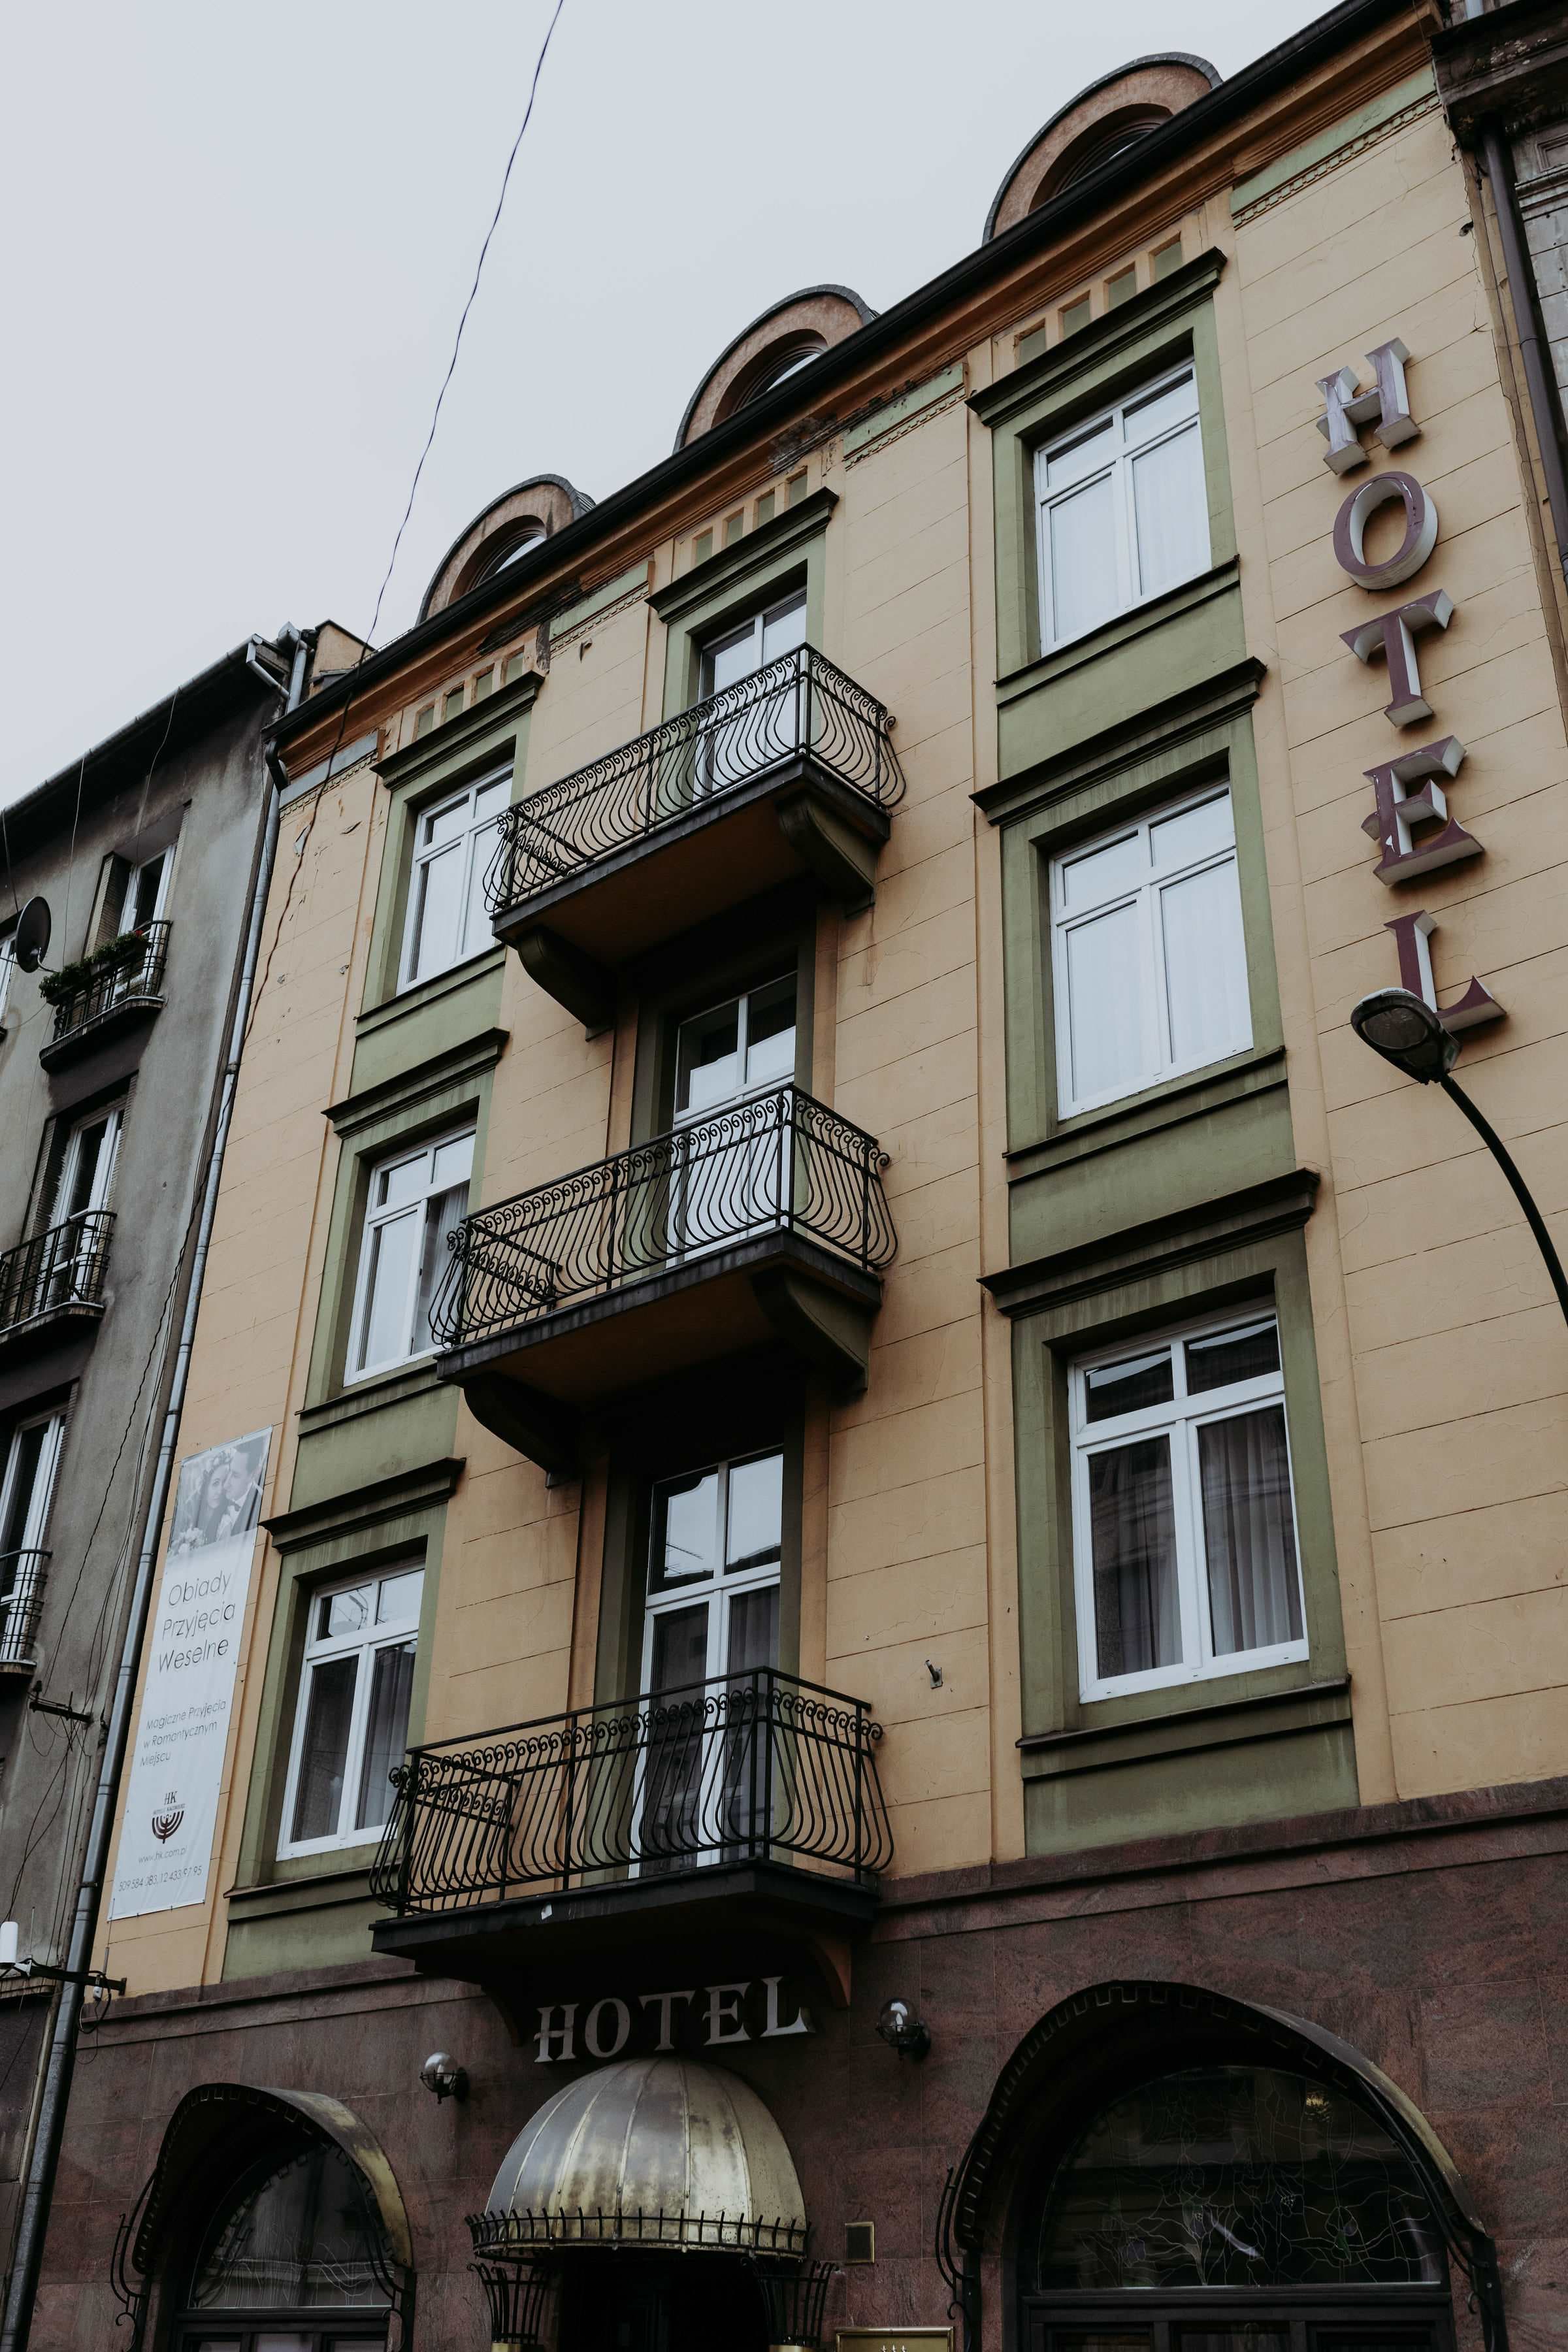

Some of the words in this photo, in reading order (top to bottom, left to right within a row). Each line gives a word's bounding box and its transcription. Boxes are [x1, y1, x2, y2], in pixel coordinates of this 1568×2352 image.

[1315, 336, 1507, 1031] HOTEL
[169, 1570, 231, 1606] Obiady
[163, 1601, 235, 1640] Przyjęcia
[159, 1639, 229, 1673] Weselne
[143, 1740, 151, 1749] w
[152, 1721, 218, 1746] Romantycznym
[146, 1714, 186, 1730] Magiczne
[140, 1751, 171, 1767] Miejscu
[164, 1791, 178, 1805] HK
[534, 1976, 810, 2063] HOTEL
